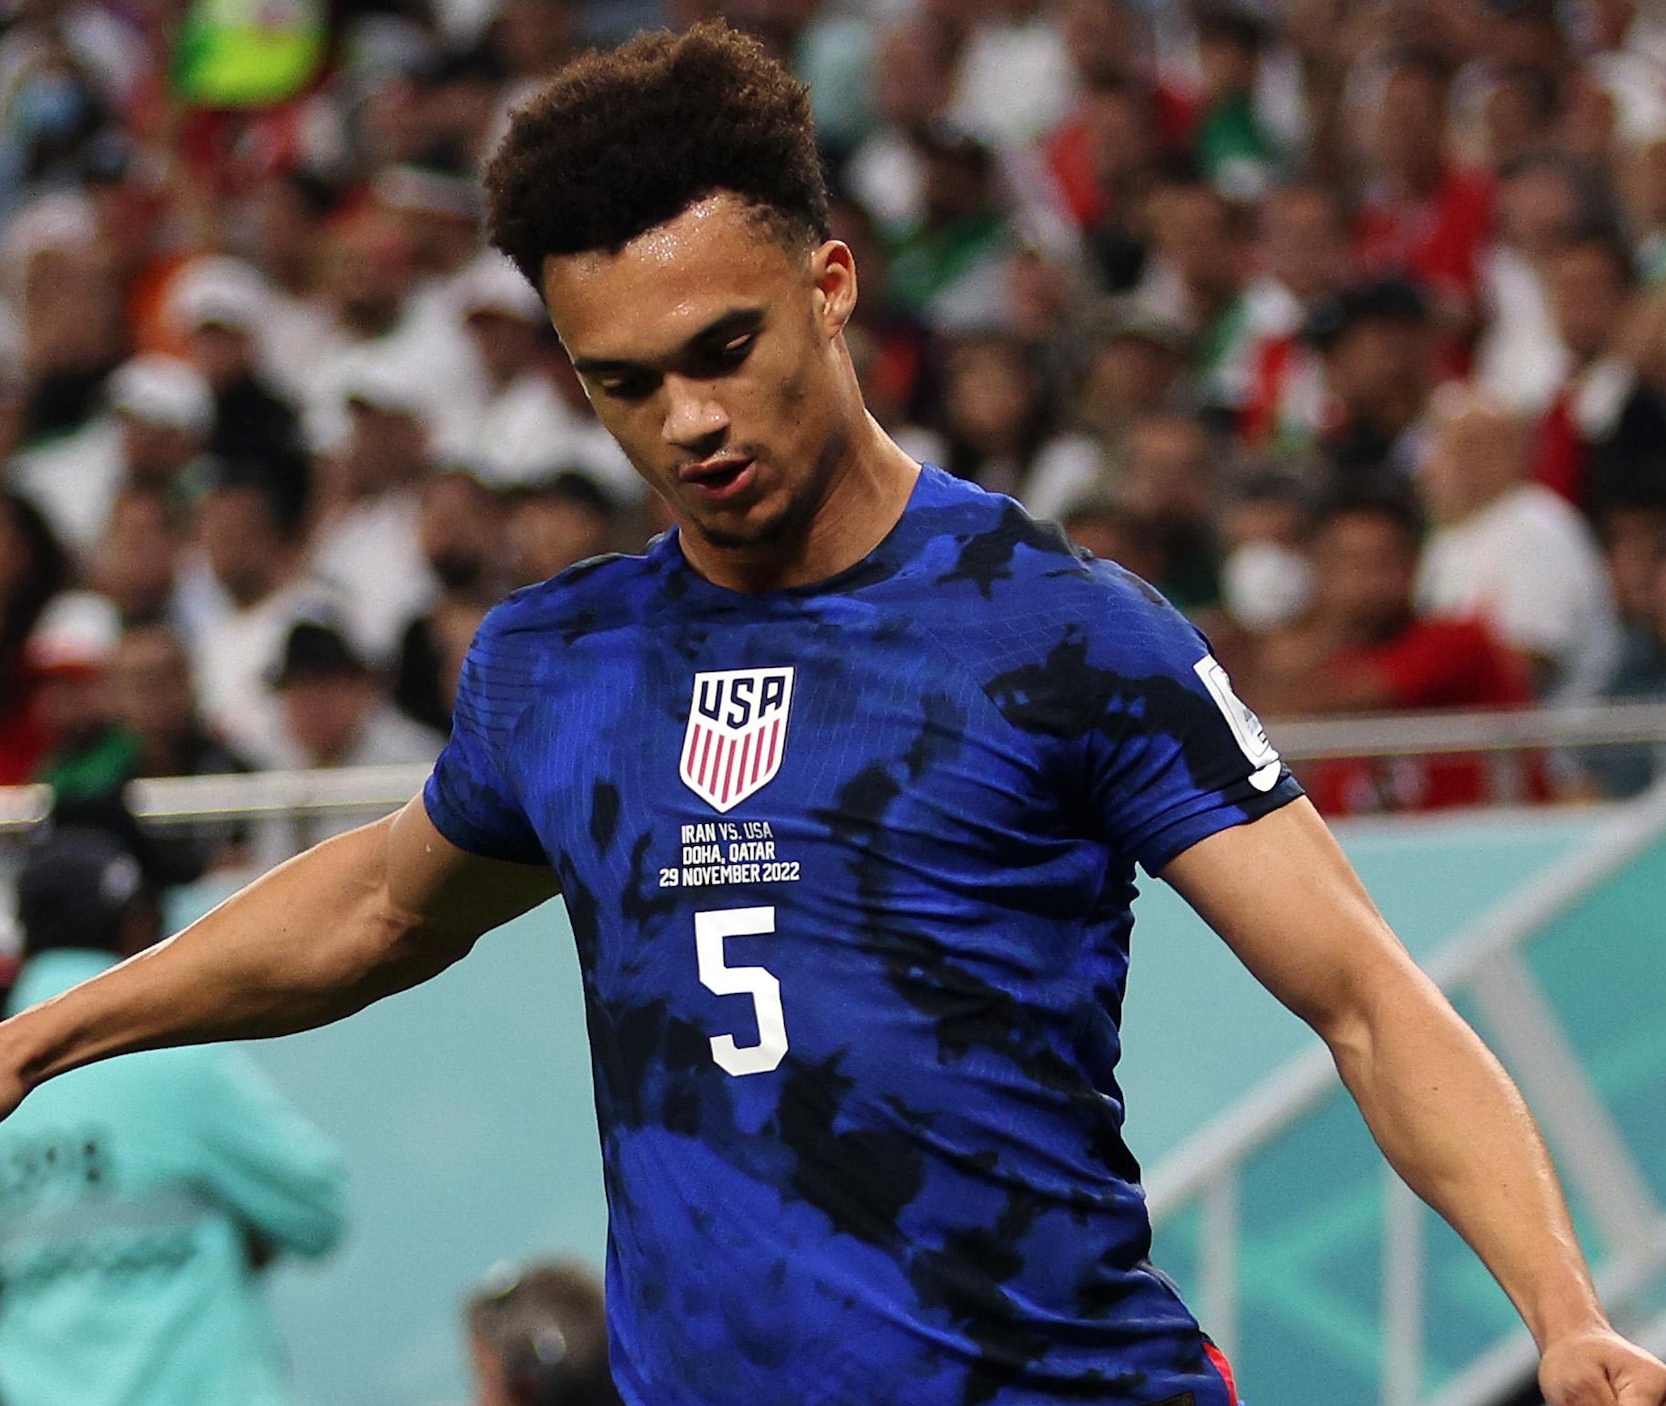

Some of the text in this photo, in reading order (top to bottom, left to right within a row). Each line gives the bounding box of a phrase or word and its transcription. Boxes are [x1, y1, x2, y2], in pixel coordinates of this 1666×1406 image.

[698, 675, 786, 730] USA
[681, 821, 773, 844] IRAN VS. USA
[682, 841, 776, 865] DOHA, QATAR
[659, 861, 800, 887] 29 NOVEMBER 2022
[694, 905, 789, 1077] 5
